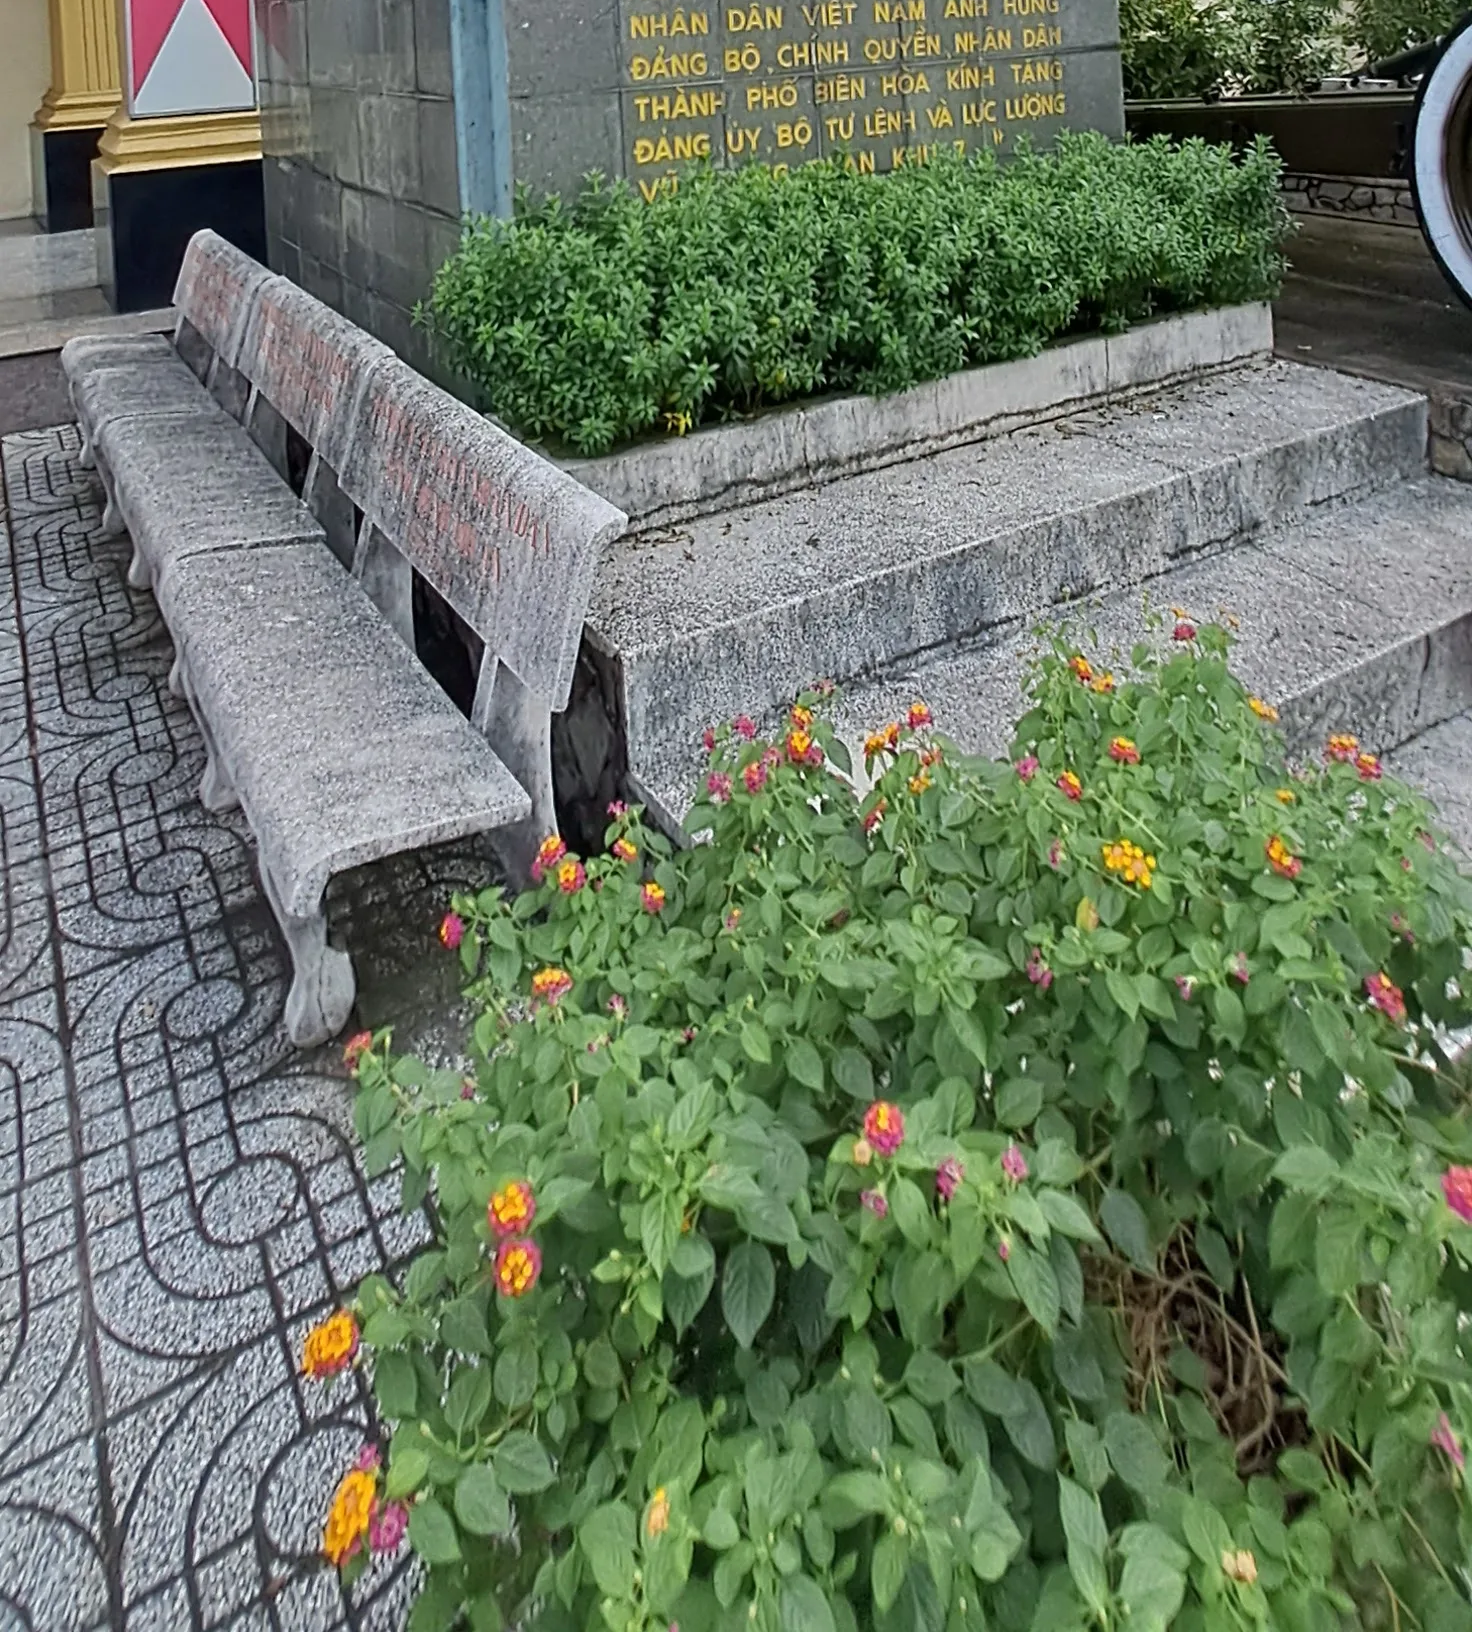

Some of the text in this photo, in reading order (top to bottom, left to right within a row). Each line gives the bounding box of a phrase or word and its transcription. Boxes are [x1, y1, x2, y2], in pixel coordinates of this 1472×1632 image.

[630, 6, 709, 40] NHÂN
[727, 2, 784, 33] DÂN
[874, 0, 927, 24] NAM
[630, 45, 708, 82] ĐẢNG
[777, 33, 850, 69] CHÍNH
[954, 26, 1012, 55] NHÂN
[1023, 23, 1063, 49] DÂN
[634, 87, 726, 122] THÀNH
[746, 76, 800, 112] PHỐ
[814, 74, 866, 105] BIÊN
[882, 64, 930, 97] HÒA
[946, 60, 995, 92] KÍNH
[633, 126, 712, 165] ĐẢNG
[776, 116, 813, 152] BỘ
[825, 111, 856, 142] TƯ
[865, 108, 916, 140] LỆNH
[926, 97, 953, 130] VÀ
[962, 99, 998, 128] LỰC
[1005, 93, 1067, 122] LƯỢNG
